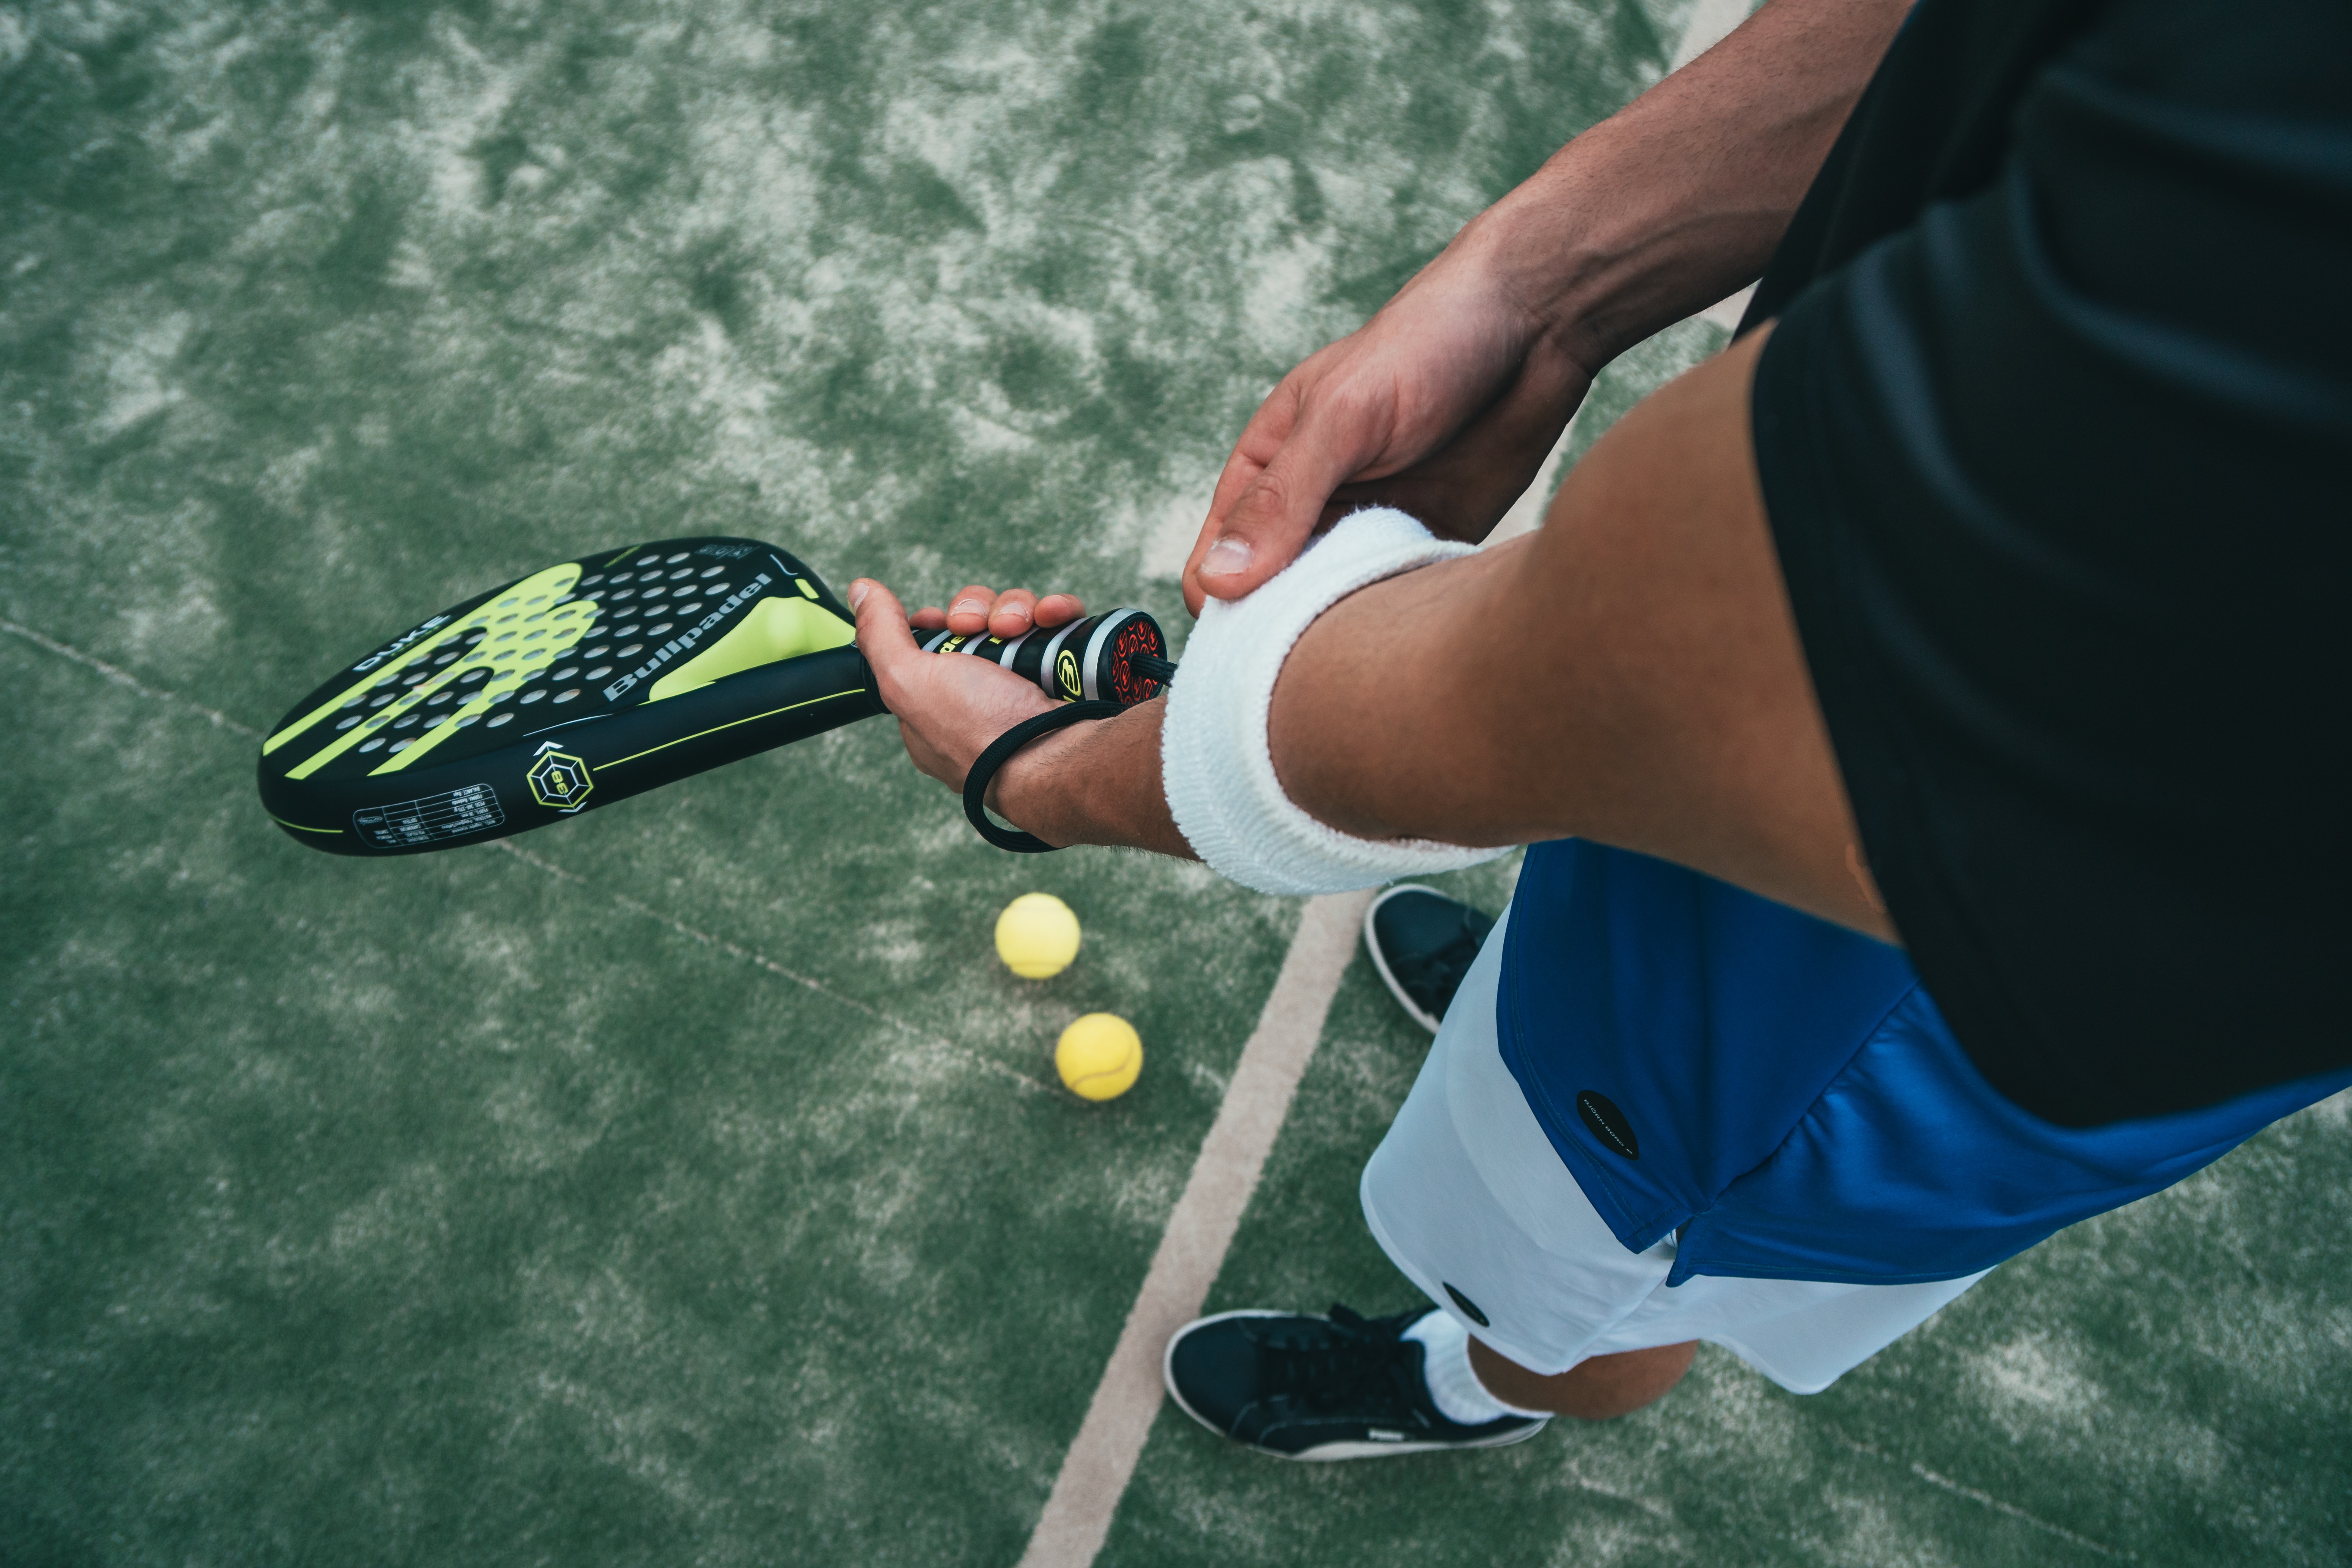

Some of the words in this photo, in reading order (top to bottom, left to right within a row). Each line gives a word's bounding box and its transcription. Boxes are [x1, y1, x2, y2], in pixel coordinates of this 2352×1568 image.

[352, 615, 450, 671] DUKE
[603, 573, 772, 701] Bullpadel
[1584, 1099, 1604, 1124] BJÖRN
[1605, 1126, 1624, 1146] BORG
